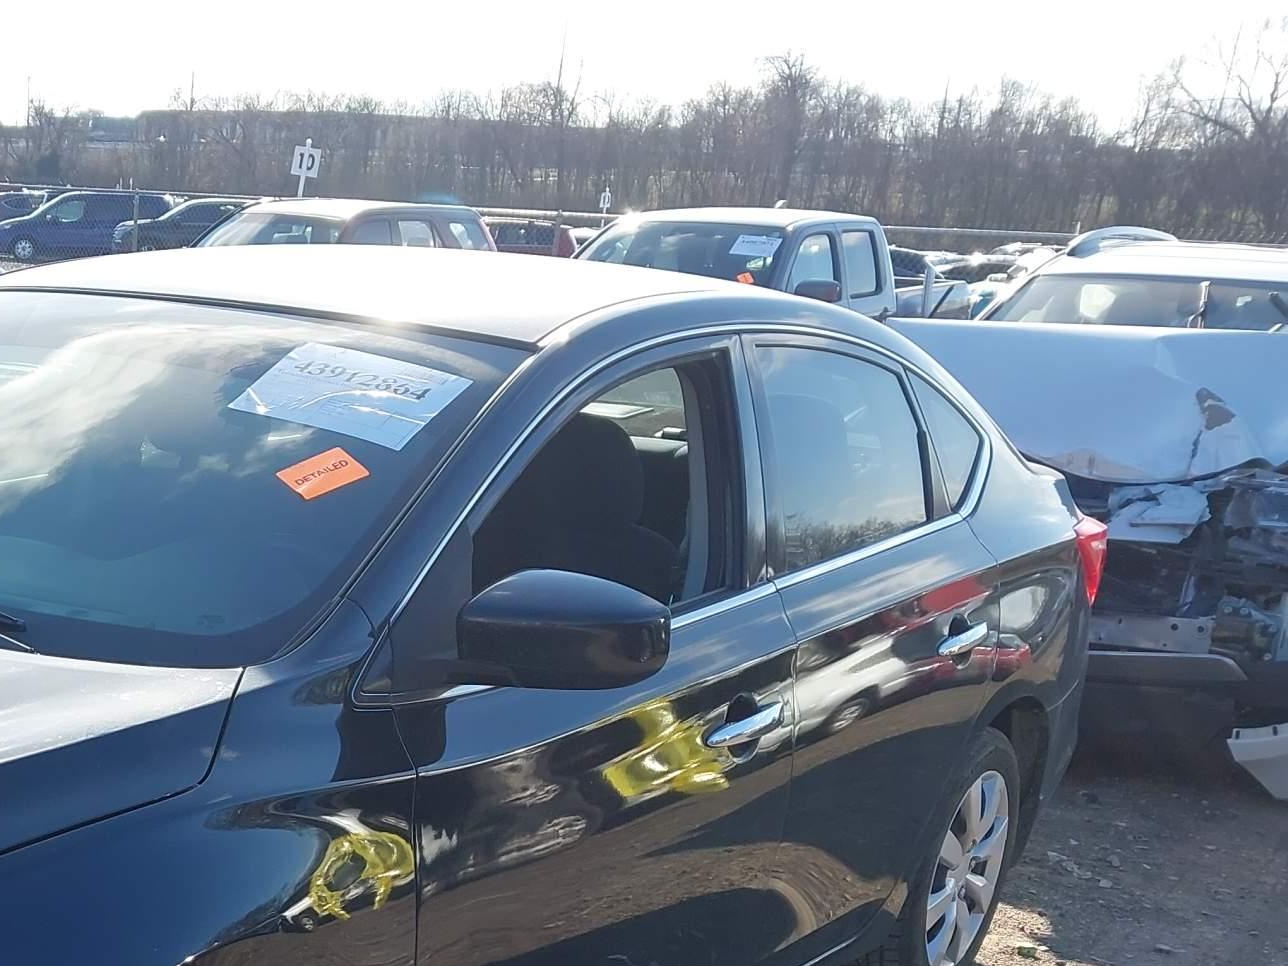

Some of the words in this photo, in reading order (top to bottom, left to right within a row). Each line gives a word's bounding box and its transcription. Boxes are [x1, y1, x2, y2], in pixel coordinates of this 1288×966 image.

[299, 152, 315, 171] 1D
[293, 360, 433, 401] 43912864
[294, 459, 349, 486] DETAILED
